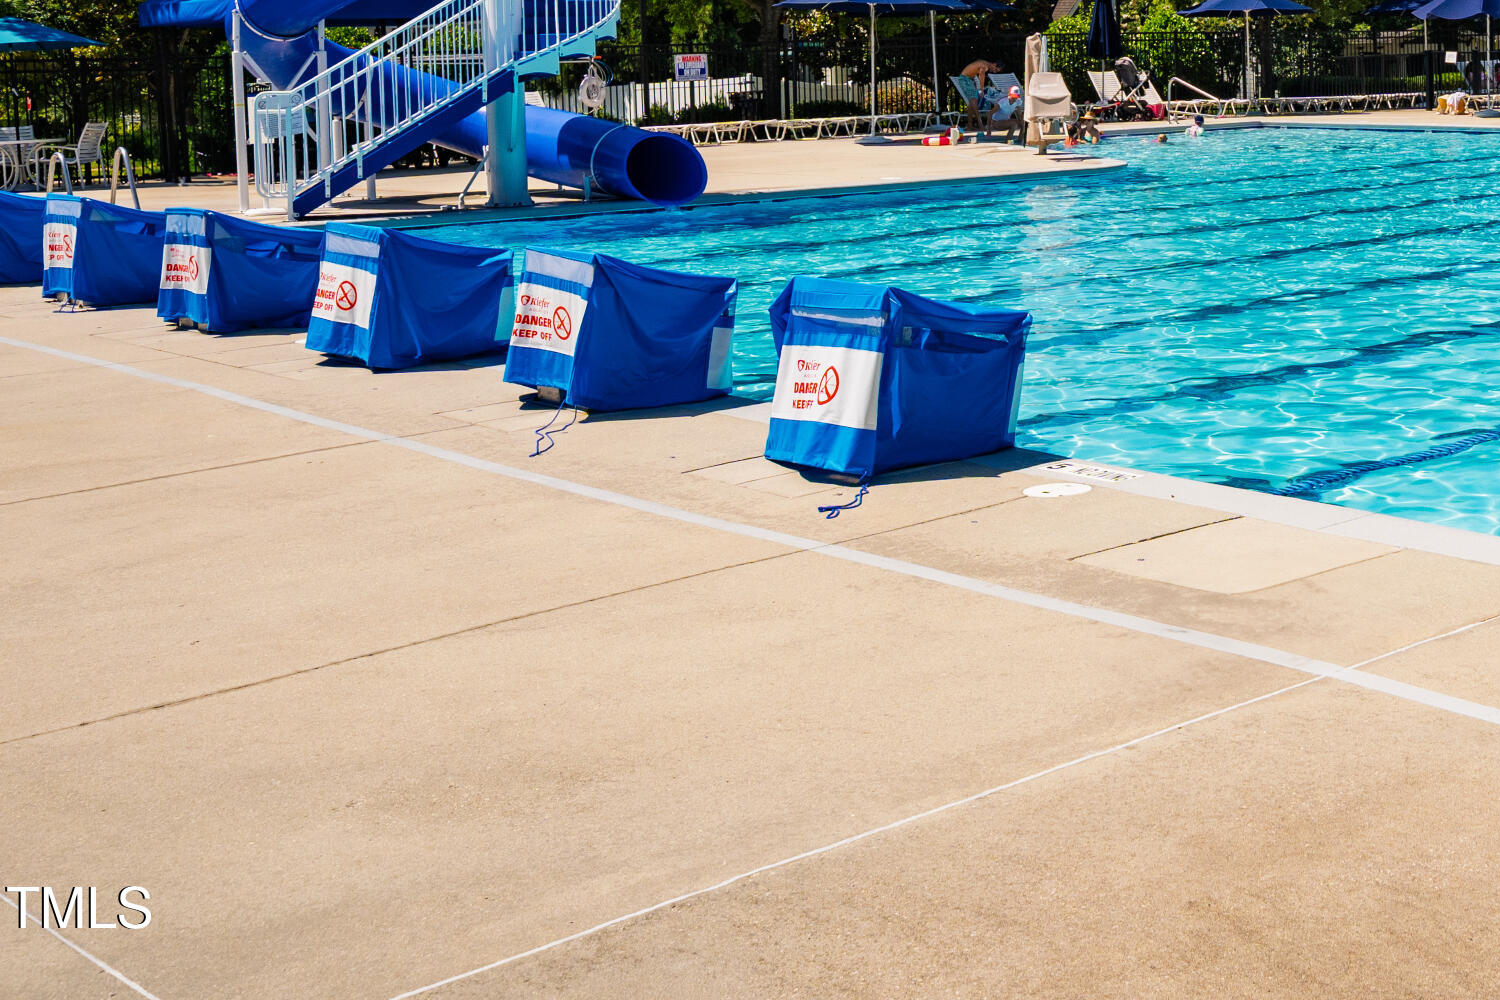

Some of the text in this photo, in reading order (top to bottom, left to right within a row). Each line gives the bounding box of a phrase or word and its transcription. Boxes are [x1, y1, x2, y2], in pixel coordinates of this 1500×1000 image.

[315, 288, 335, 300] ANGER
[530, 297, 550, 308] Kiefer
[515, 313, 552, 328] DANGER
[512, 328, 552, 341] KEEP OFF
